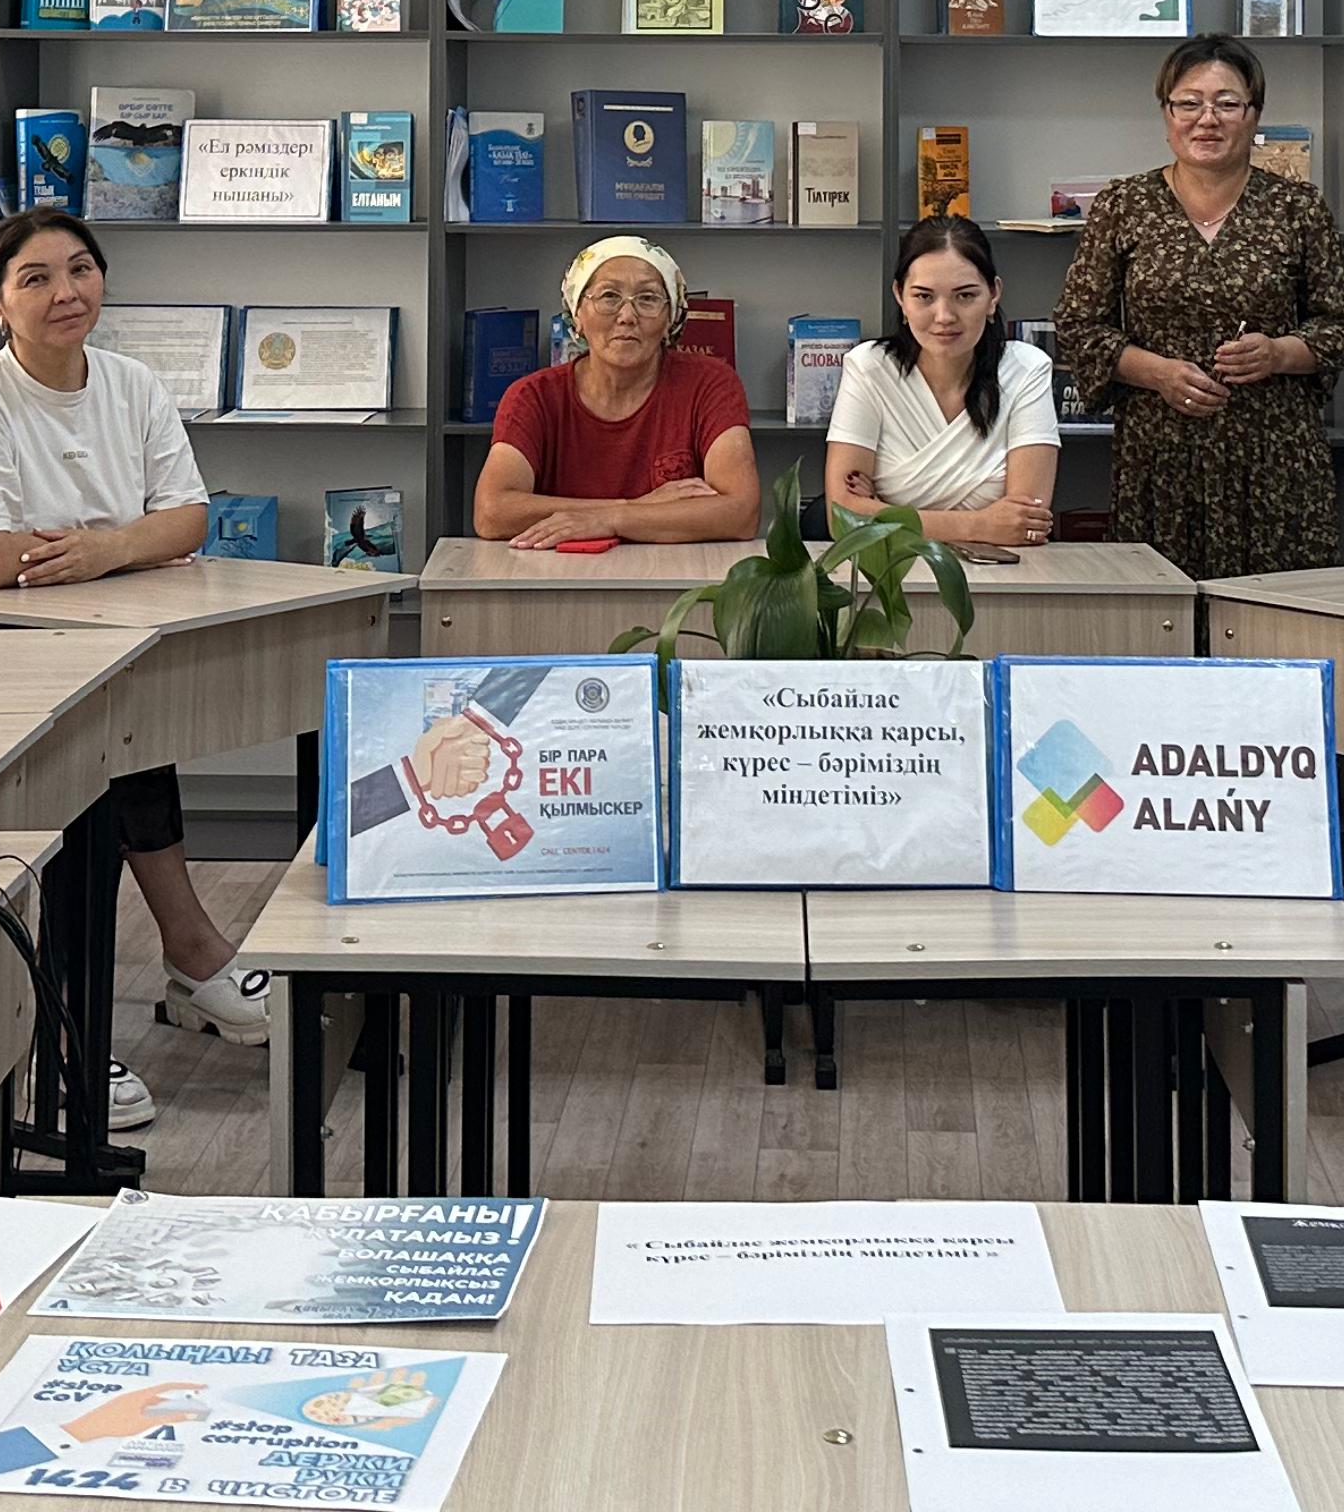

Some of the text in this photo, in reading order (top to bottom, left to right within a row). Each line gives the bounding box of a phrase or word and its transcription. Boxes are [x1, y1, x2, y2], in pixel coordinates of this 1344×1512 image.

[199, 138, 314, 157] «Ел рәміздері
[220, 164, 290, 182] еркіндік
[212, 190, 294, 202] нышаны»
[351, 192, 401, 207] ЕЛТАНЫМ
[762, 687, 900, 709] «Сыбайлас
[697, 723, 966, 746] жемқорлыққа қарсы,
[539, 748, 608, 763] БІР ПАРА
[722, 755, 791, 777] күрес
[818, 752, 941, 777] бәріміздің
[1131, 743, 1317, 780] ADALDYQ
[538, 766, 592, 797] ЕКІ
[761, 784, 902, 806] міндетіміз»
[539, 800, 643, 821] ҚЫЛМЫСКЕР
[1133, 788, 1271, 832] ALAŃY
[260, 1203, 512, 1224] ҚАБЫРҒАНЫ
[645, 1238, 763, 1249] Сыбайлас
[769, 1236, 935, 1248] жемқорлыққа
[943, 1235, 1016, 1247] қарсы
[338, 1248, 511, 1264] БОЛАШАҚҚА
[646, 1253, 710, 1264] күрес
[386, 1263, 507, 1277] СЫБАЙЛАС
[384, 1291, 495, 1305] ҚАДАМ!
[66, 1341, 380, 1368] ҚОЛЫҢДЫ ТАЗА
[33, 1388, 93, 1403] CoV
[42, 1379, 123, 1395] #stop
[210, 1420, 293, 1436] #stop
[201, 1433, 359, 1450] corruption
[258, 1451, 415, 1471] ДЕРЖИ
[24, 1468, 144, 1490] 1424
[294, 1468, 407, 1488] РУКИ
[207, 1479, 400, 1504] ЧИСТОТЕ
